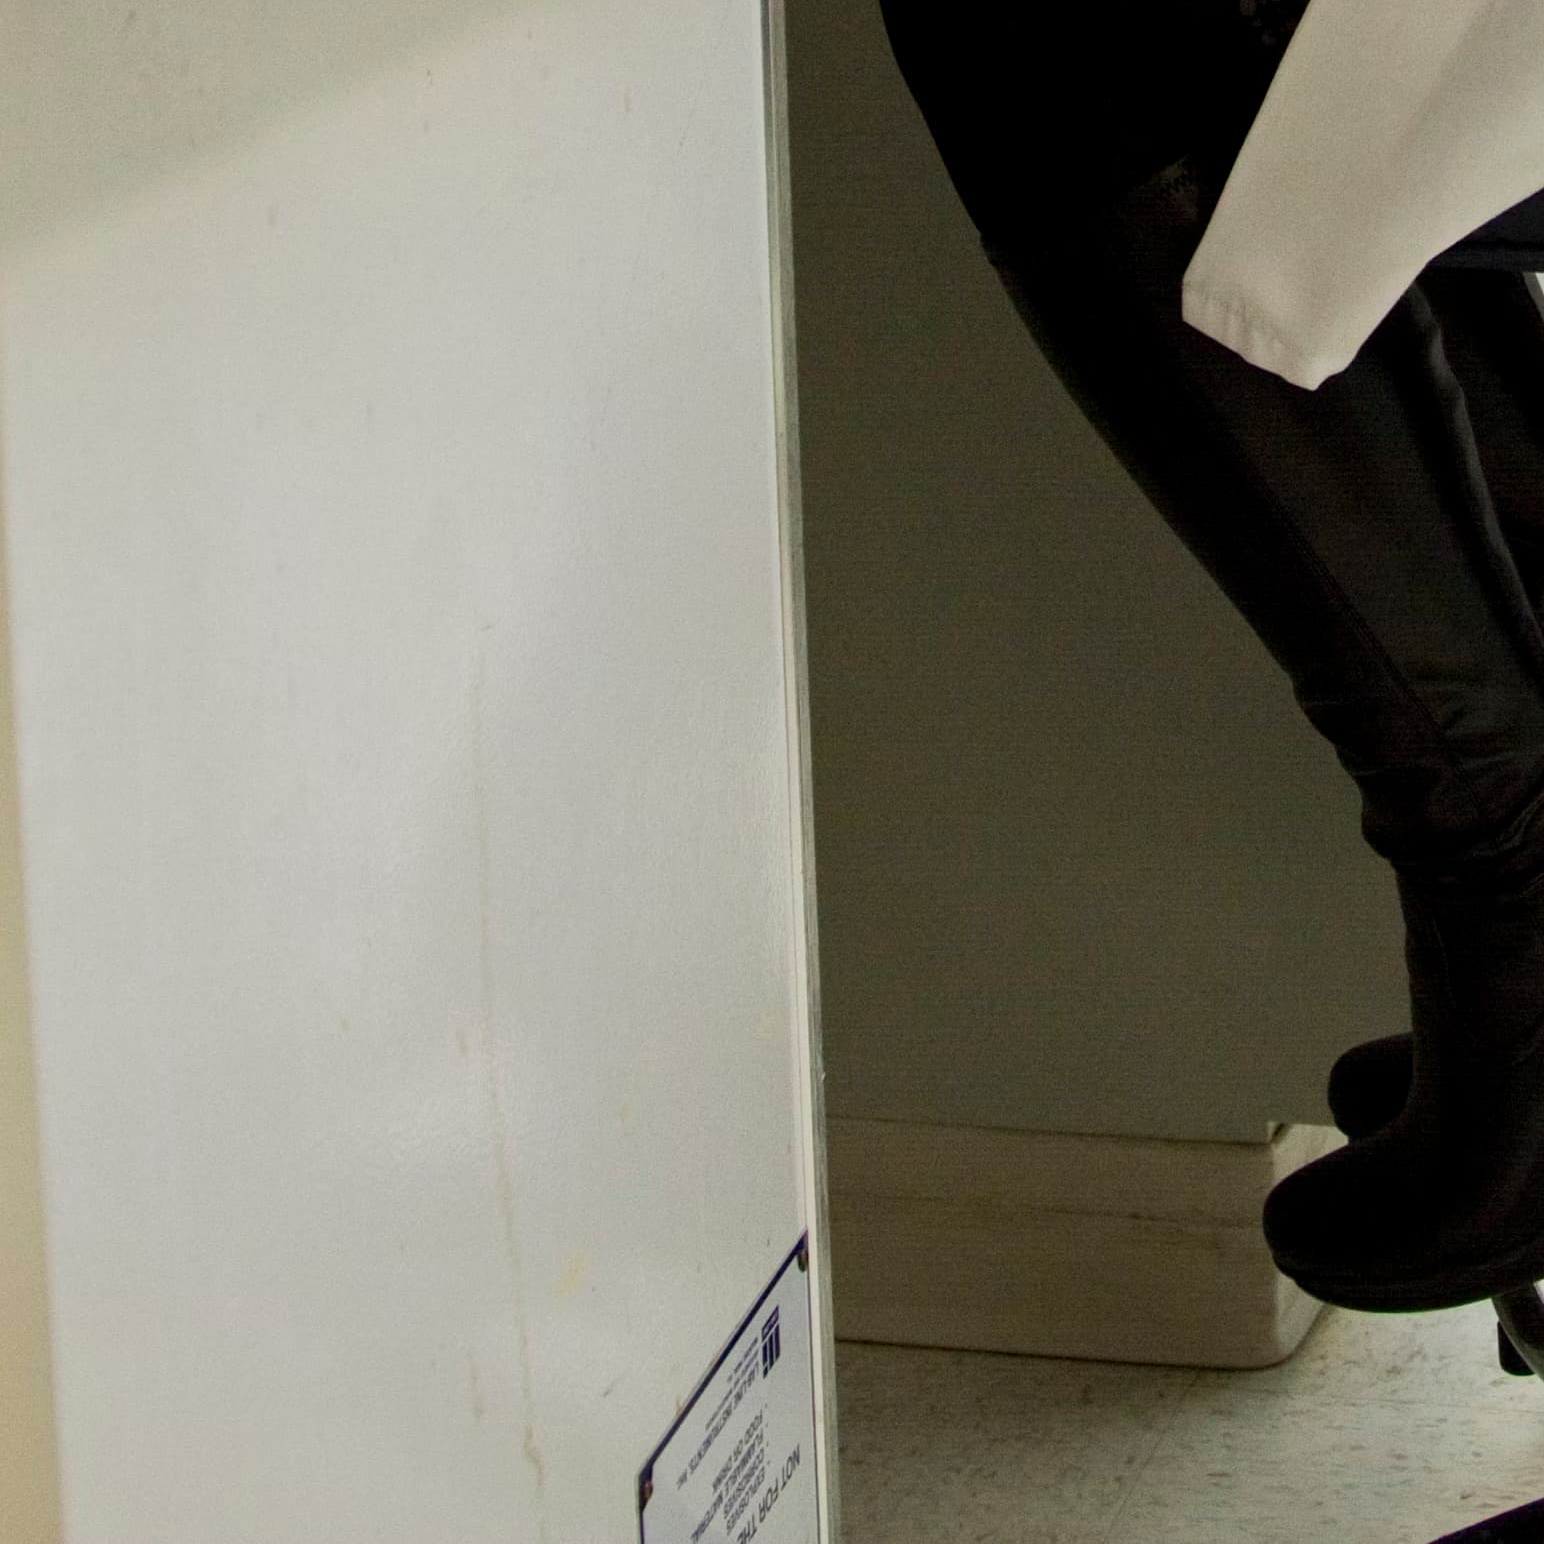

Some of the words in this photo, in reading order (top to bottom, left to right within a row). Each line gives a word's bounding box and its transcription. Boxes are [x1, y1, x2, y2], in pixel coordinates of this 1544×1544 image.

[723, 1448, 765, 1521] CORROSIVES
[758, 1476, 779, 1518] FOR
[780, 1443, 801, 1492] NOT
[726, 1465, 766, 1537] EXPLOSIVES
